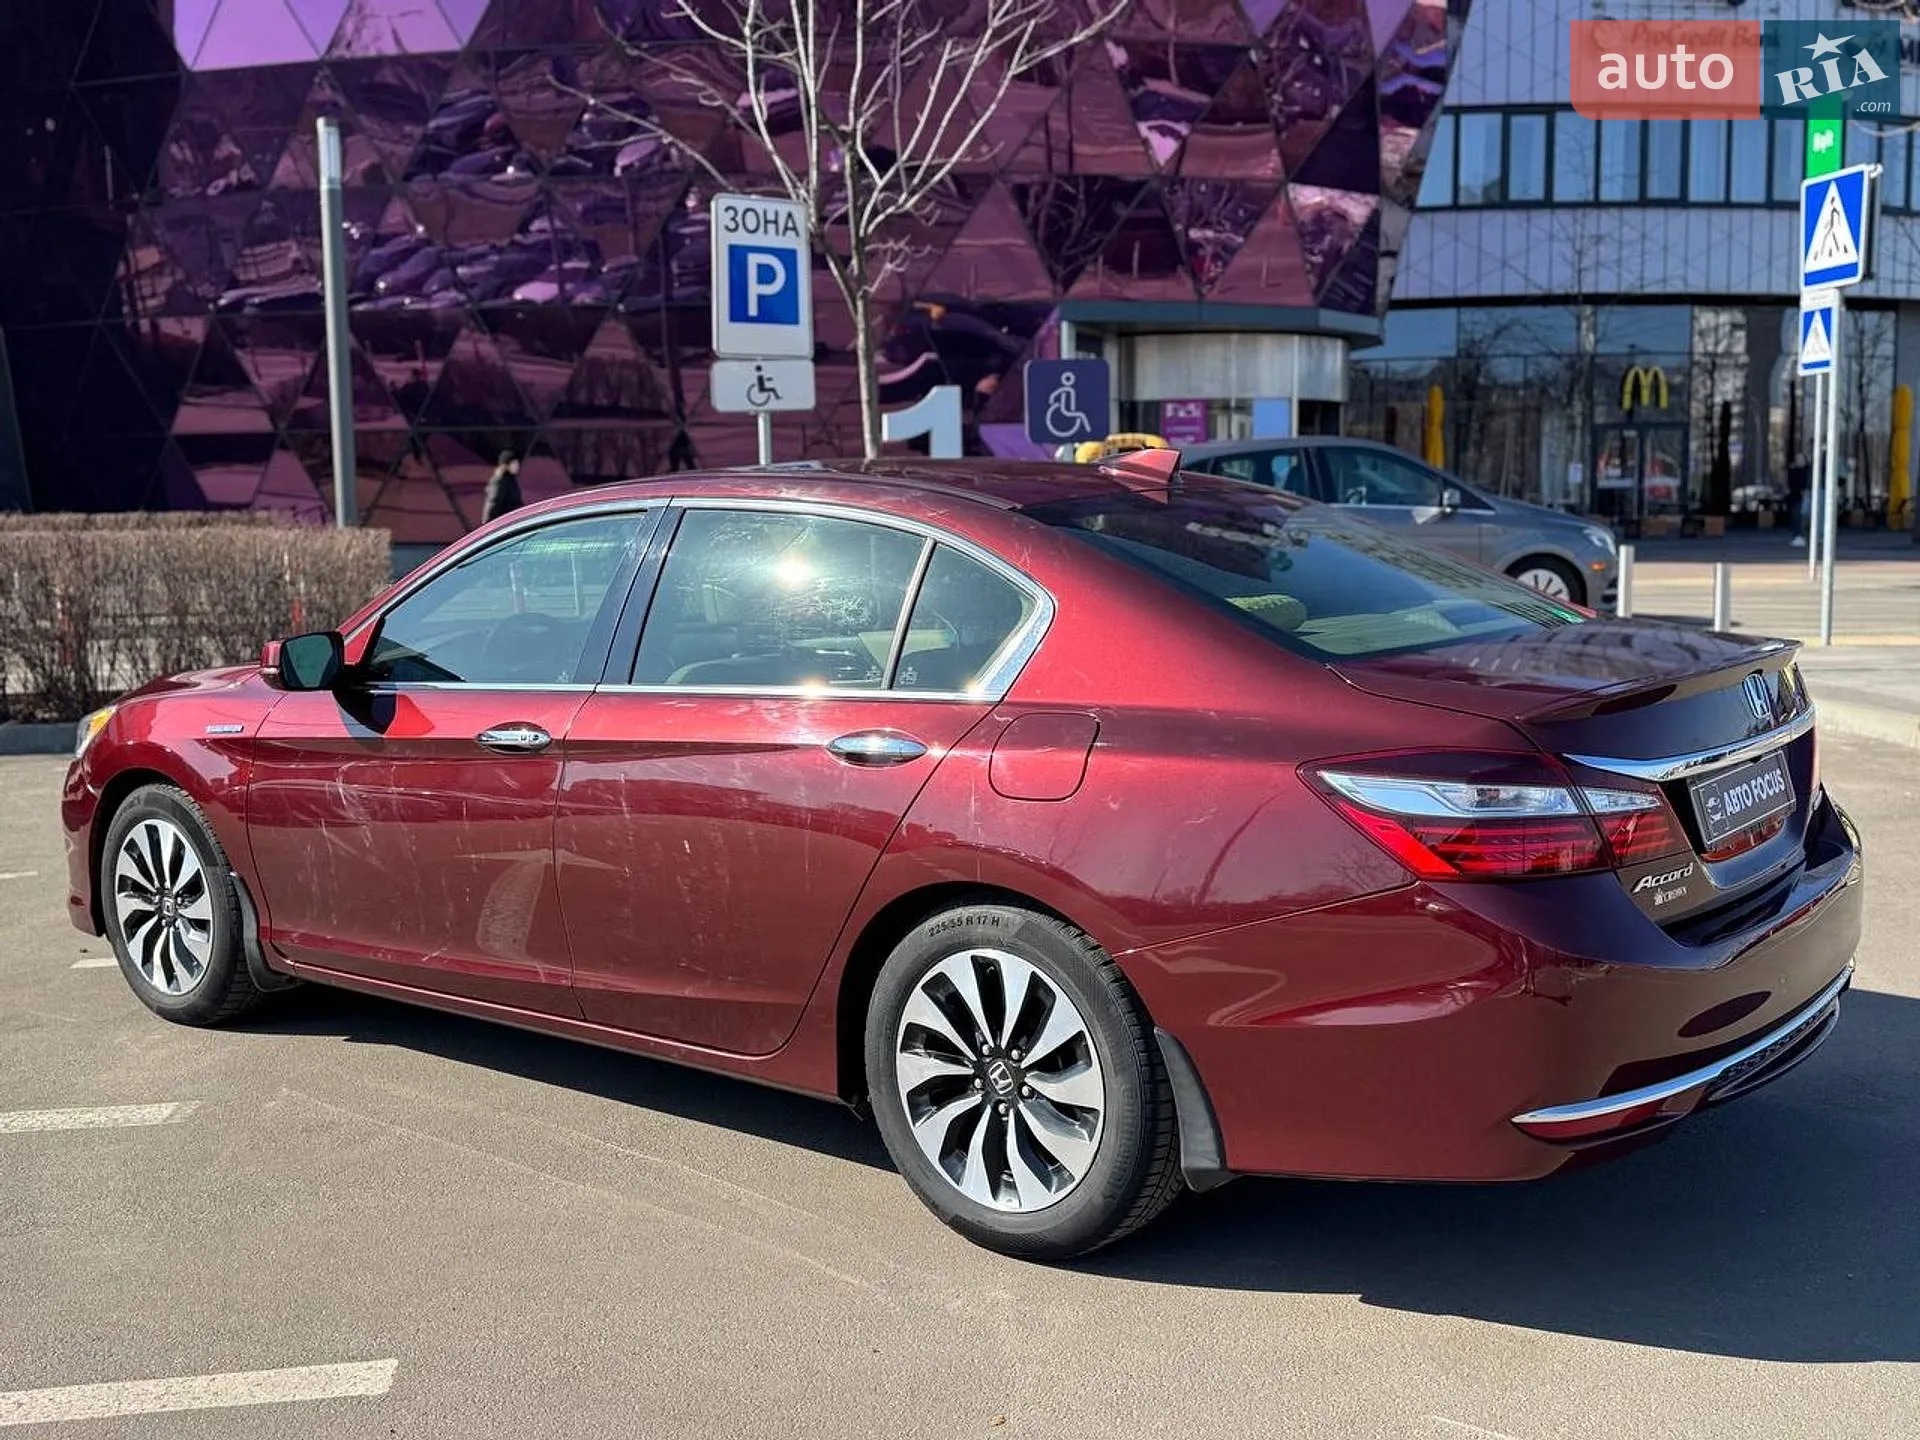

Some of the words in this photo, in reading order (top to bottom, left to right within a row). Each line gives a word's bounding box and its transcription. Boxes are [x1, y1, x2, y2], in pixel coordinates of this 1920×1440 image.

[724, 206, 799, 237] ЗОНА
[747, 252, 786, 317] P
[882, 385, 962, 459] 1
[1750, 767, 1785, 803] FOCUS
[1632, 862, 1693, 893] Accord
